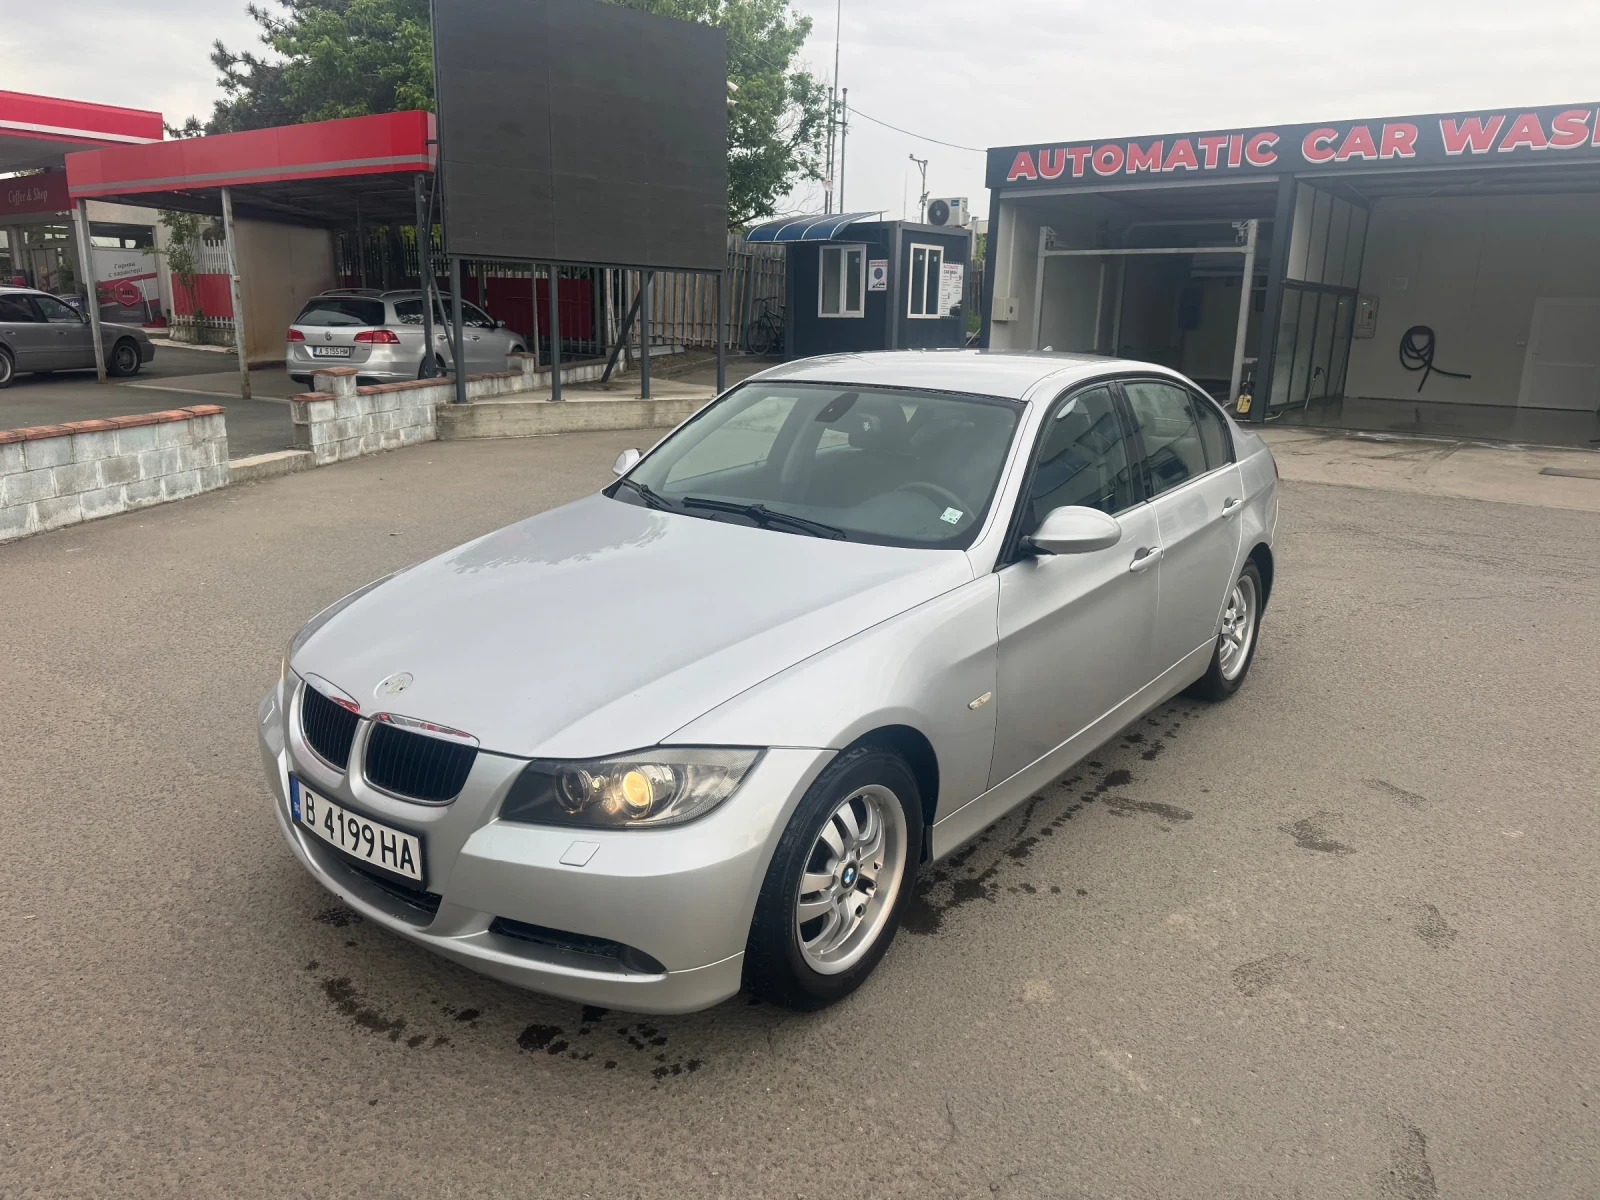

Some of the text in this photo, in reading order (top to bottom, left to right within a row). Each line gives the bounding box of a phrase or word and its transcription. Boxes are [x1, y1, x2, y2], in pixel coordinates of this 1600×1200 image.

[1006, 107, 1600, 181] AUTOMATIC CAR WAS
[8, 187, 48, 206] Coffee & Shop
[113, 267, 143, 277] характер!
[114, 262, 136, 270] Горива
[305, 791, 416, 874] B 4199 HA
